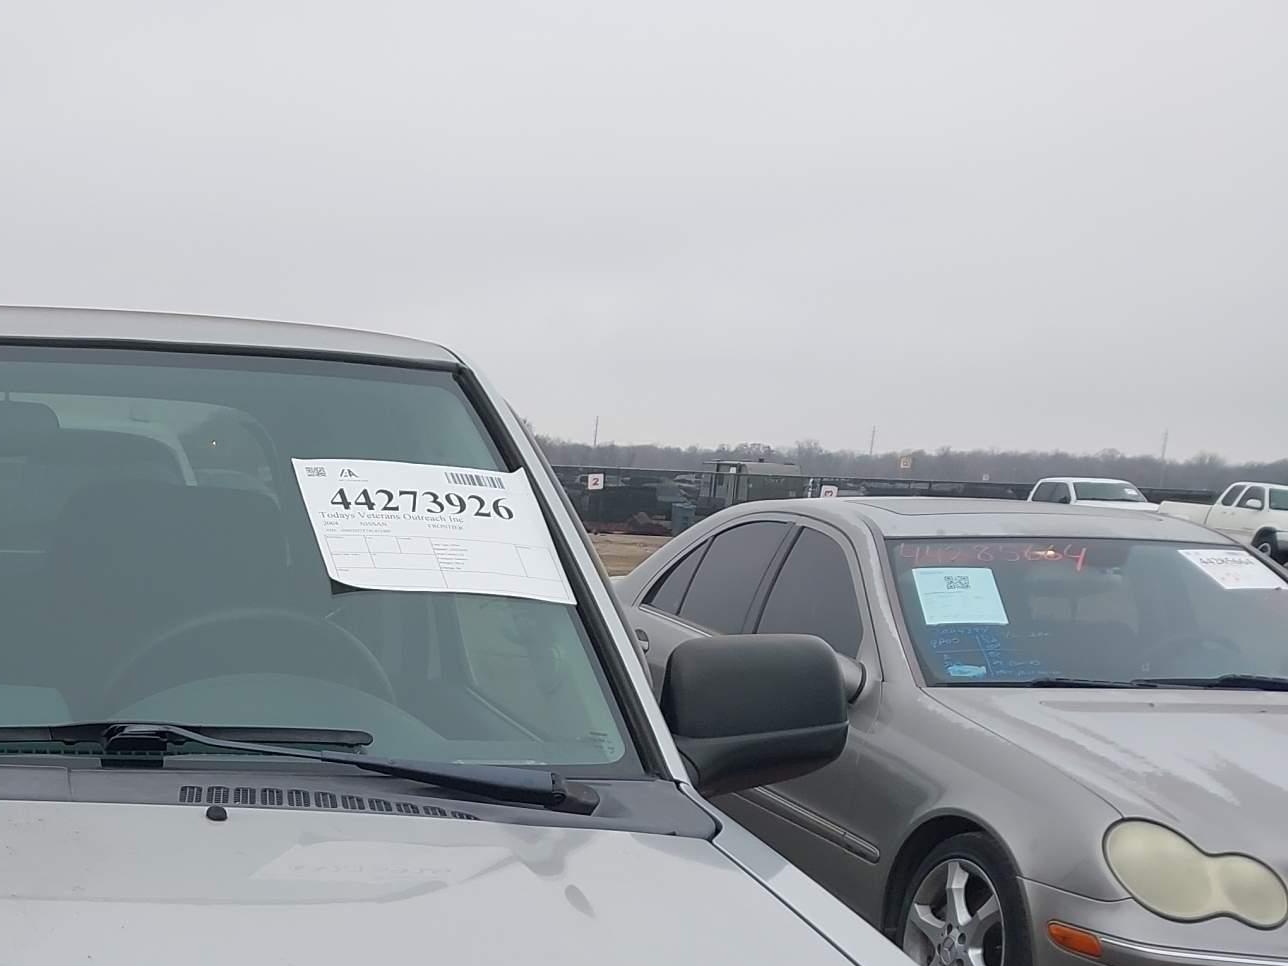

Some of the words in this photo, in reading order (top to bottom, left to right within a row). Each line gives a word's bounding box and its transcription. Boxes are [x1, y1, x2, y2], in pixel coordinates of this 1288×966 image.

[330, 487, 514, 521] 44273926
[319, 511, 355, 520] Todays
[358, 511, 401, 520] Veterans
[403, 513, 446, 522] Outreach
